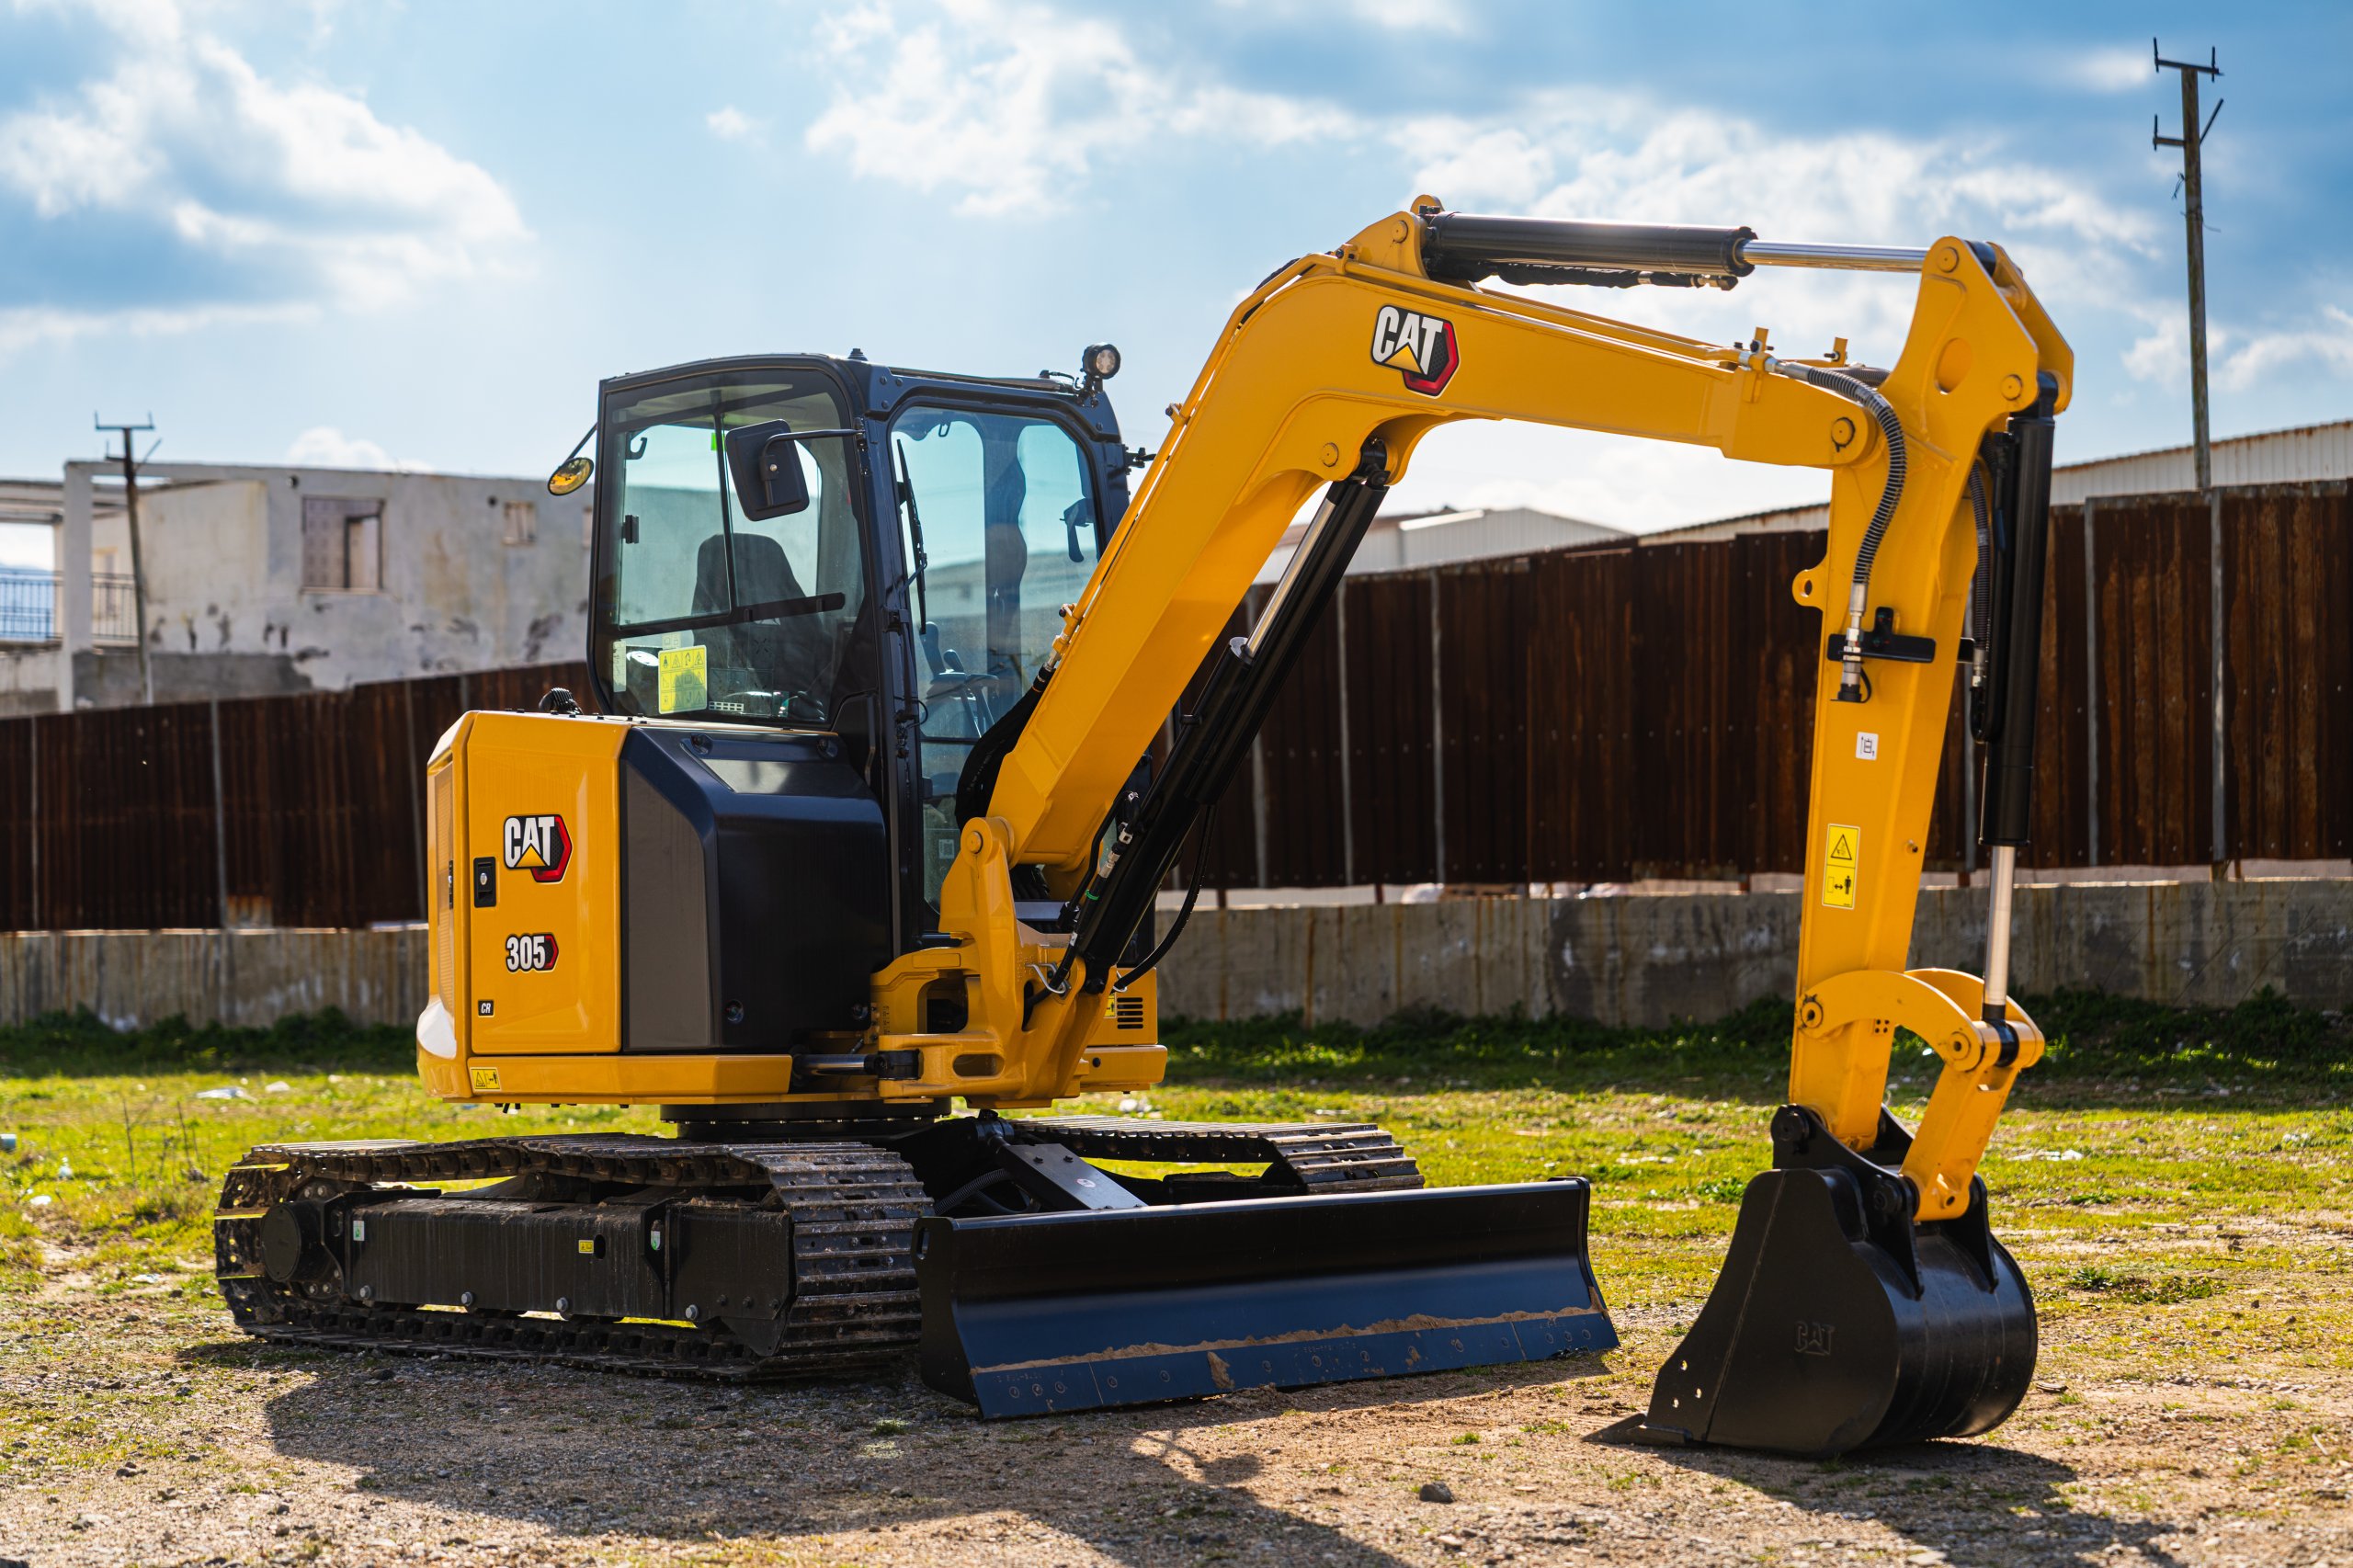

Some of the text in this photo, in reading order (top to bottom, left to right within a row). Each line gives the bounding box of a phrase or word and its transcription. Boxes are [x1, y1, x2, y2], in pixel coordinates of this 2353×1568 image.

[1372, 306, 1444, 375] CAT
[504, 816, 555, 868] CAT
[506, 936, 546, 971] 305
[481, 1003, 492, 1014] CR
[1794, 1320, 1836, 1356] CAT
